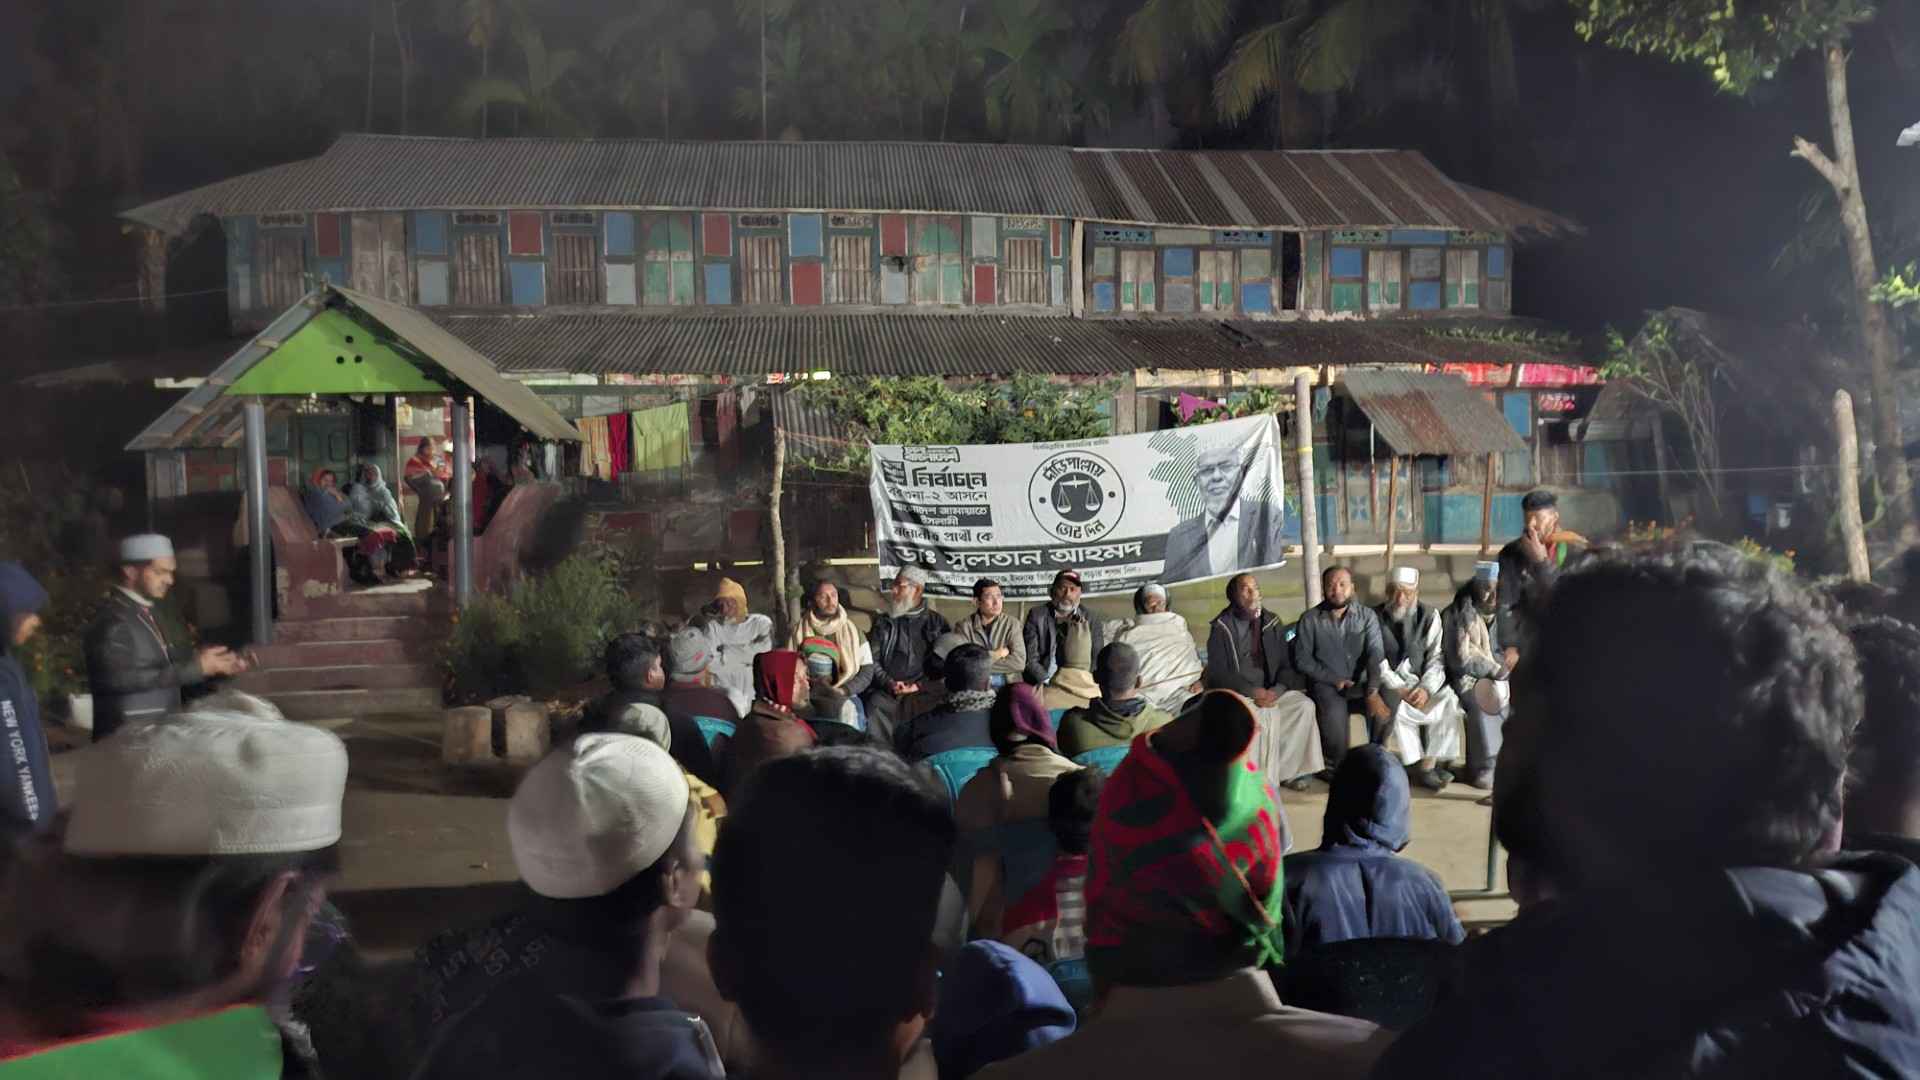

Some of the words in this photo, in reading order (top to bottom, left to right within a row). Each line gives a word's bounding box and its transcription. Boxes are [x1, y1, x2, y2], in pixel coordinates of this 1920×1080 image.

[912, 466, 988, 490] নির্বাচনে
[944, 490, 988, 503] আসনে
[976, 531, 994, 544] কে
[1056, 521, 1082, 539] ভোট
[1084, 519, 1106, 537] দিন
[895, 545, 937, 564] ডাঃ
[945, 549, 1042, 571] সুলতান
[1050, 541, 1143, 563] আহমদ
[2, 700, 18, 728] NEW
[9, 730, 28, 765] YORK
[18, 766, 40, 821] YANKEES
